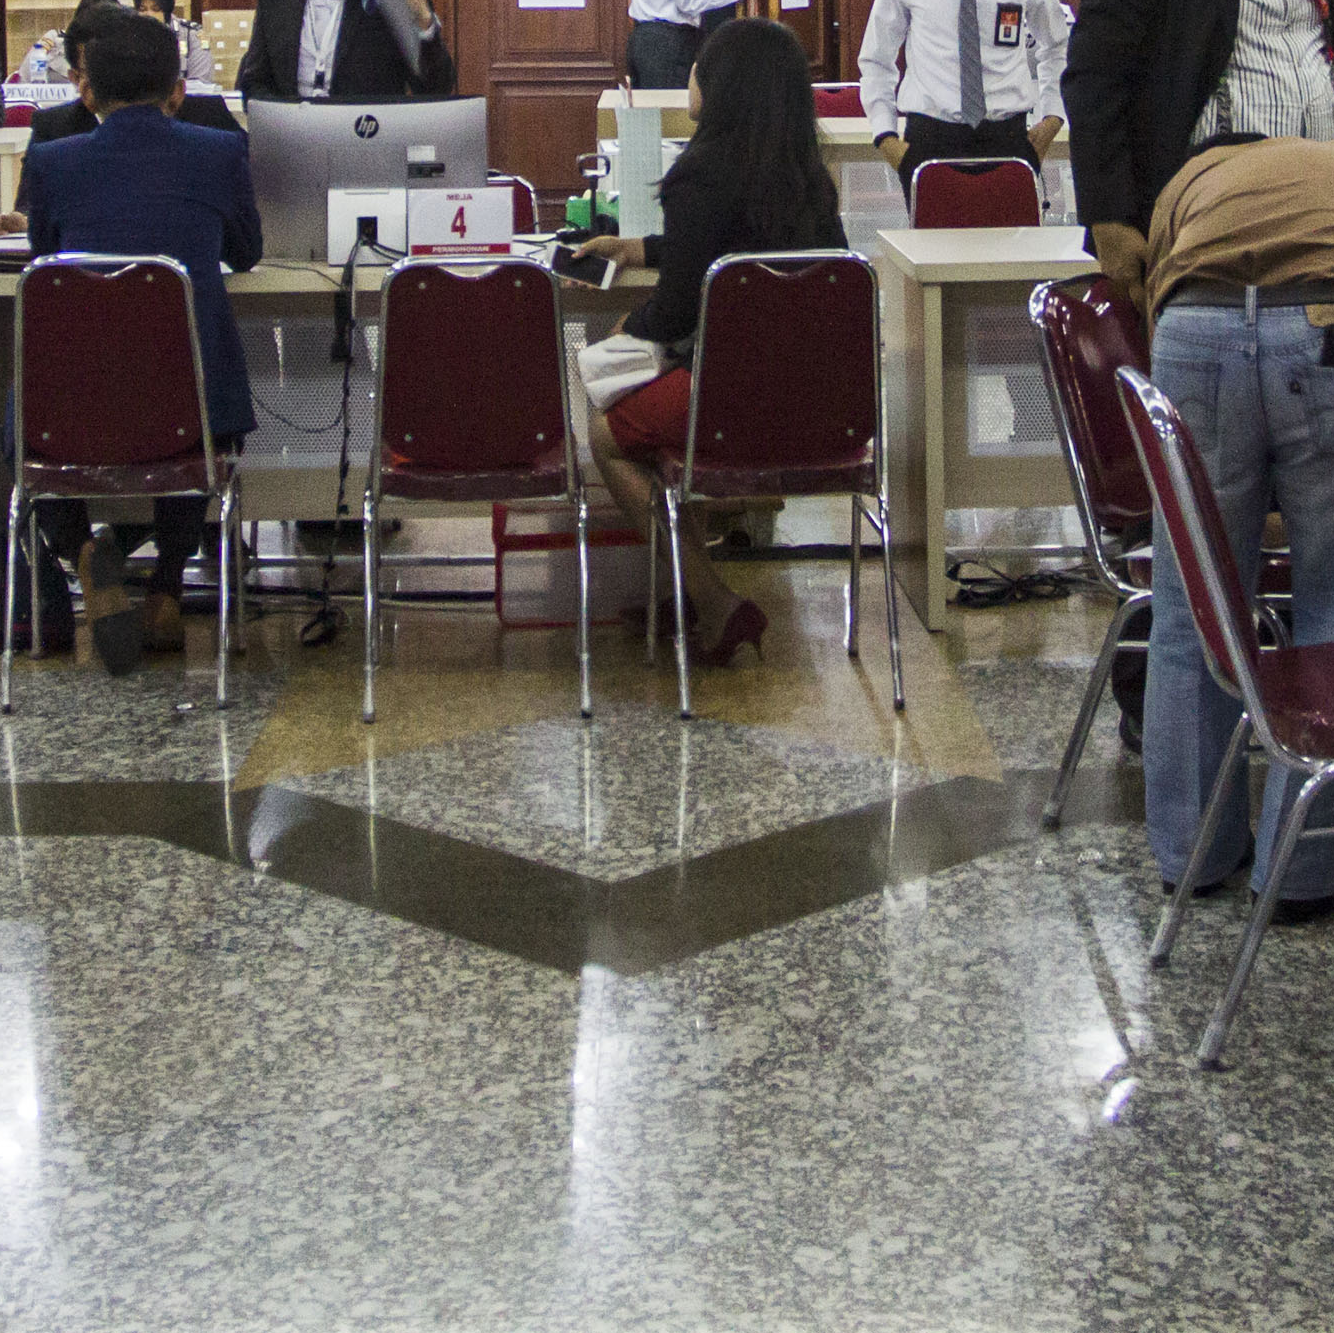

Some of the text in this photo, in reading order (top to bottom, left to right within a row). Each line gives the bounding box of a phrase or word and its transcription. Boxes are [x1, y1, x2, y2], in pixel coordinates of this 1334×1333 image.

[6, 87, 68, 100] PENGAMANAN
[355, 114, 379, 139] hp
[446, 193, 473, 201] MEJA
[451, 205, 467, 239] 4
